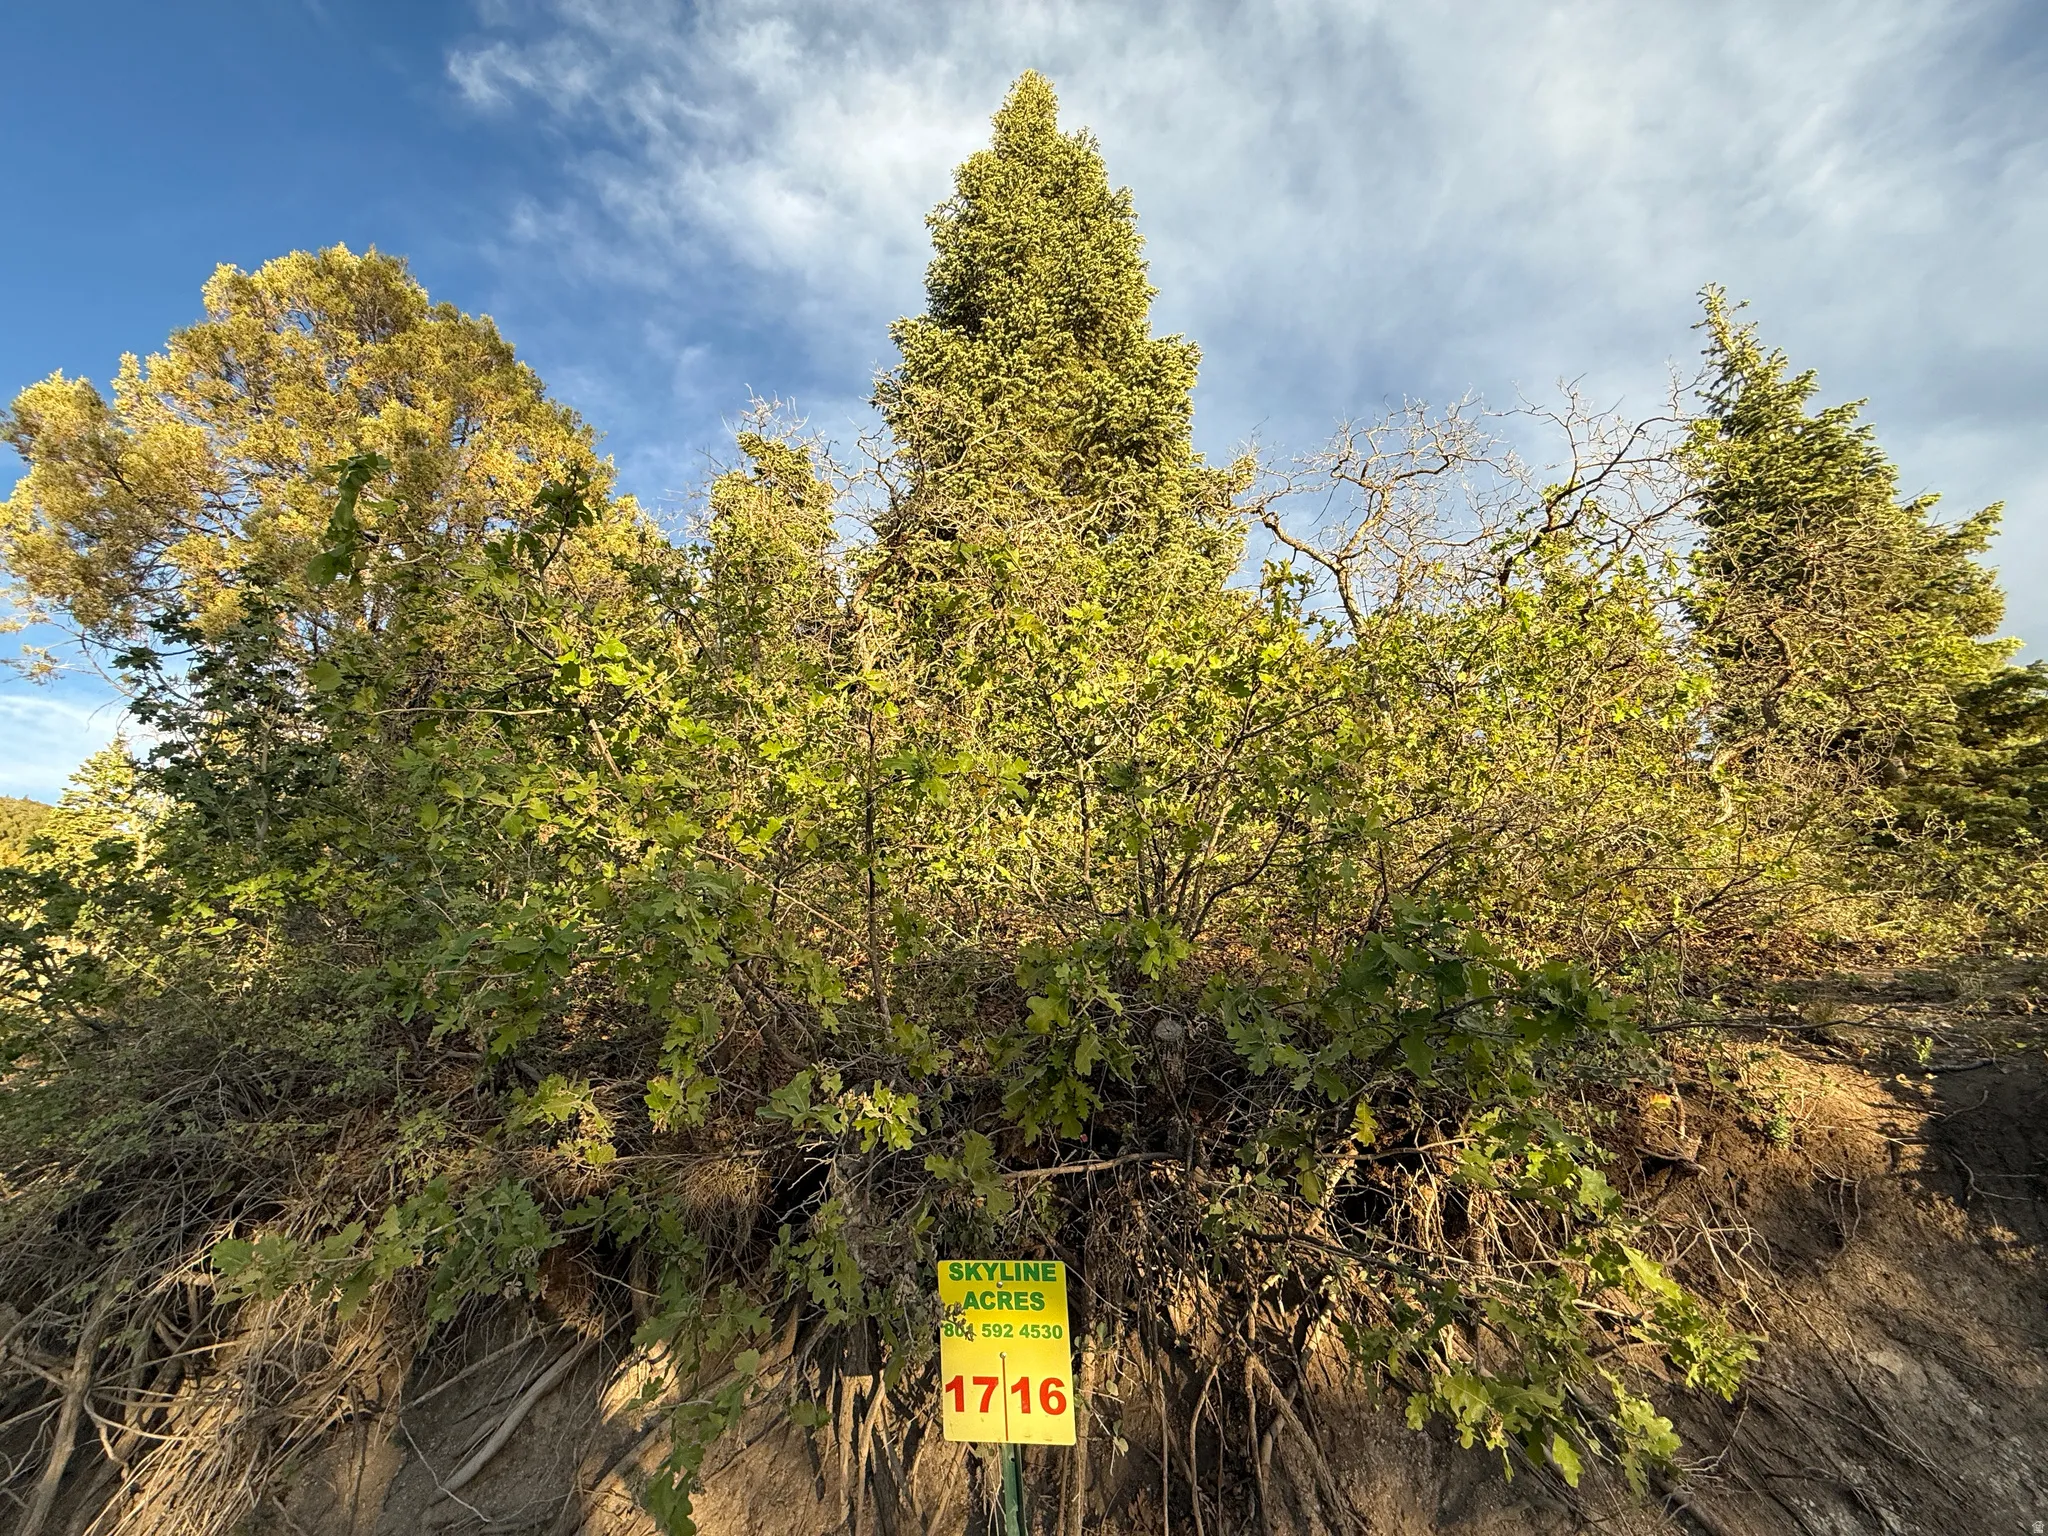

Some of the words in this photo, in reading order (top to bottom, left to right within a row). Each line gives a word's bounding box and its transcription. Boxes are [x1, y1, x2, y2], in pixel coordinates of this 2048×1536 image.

[948, 1262, 1057, 1282] SKYLINE
[963, 1291, 1046, 1311] ACRES
[981, 1323, 1014, 1338] 592
[1019, 1324, 1063, 1339] 4530
[945, 1375, 999, 1413] 17
[1010, 1376, 1067, 1415] 16
